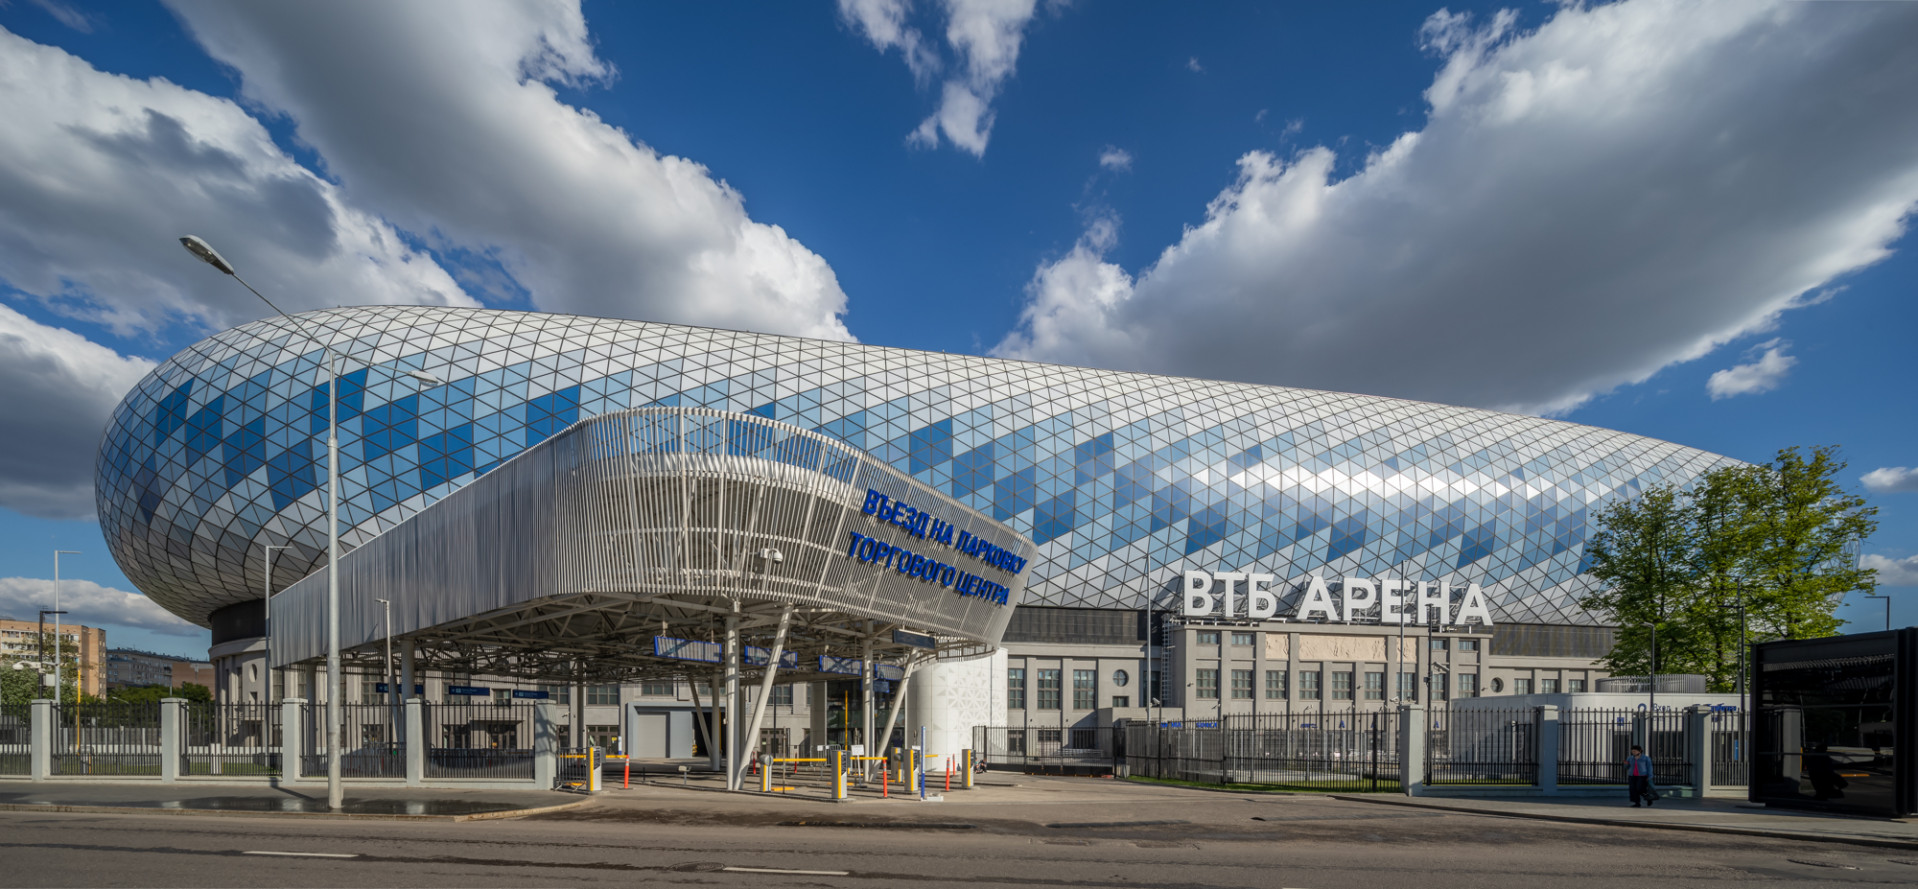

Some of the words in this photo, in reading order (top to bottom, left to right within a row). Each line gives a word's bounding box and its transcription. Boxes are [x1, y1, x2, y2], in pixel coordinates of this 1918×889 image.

[850, 531, 956, 587] ТОРГОВОГО
[955, 571, 1010, 606] ЦЕНТРА
[862, 488, 930, 540] ВЪЕЗД
[930, 517, 955, 546] НА
[956, 530, 1028, 575] ПАРКОВКУ
[1184, 570, 1277, 619] ВТБ
[1296, 576, 1494, 626] АРЕНА
